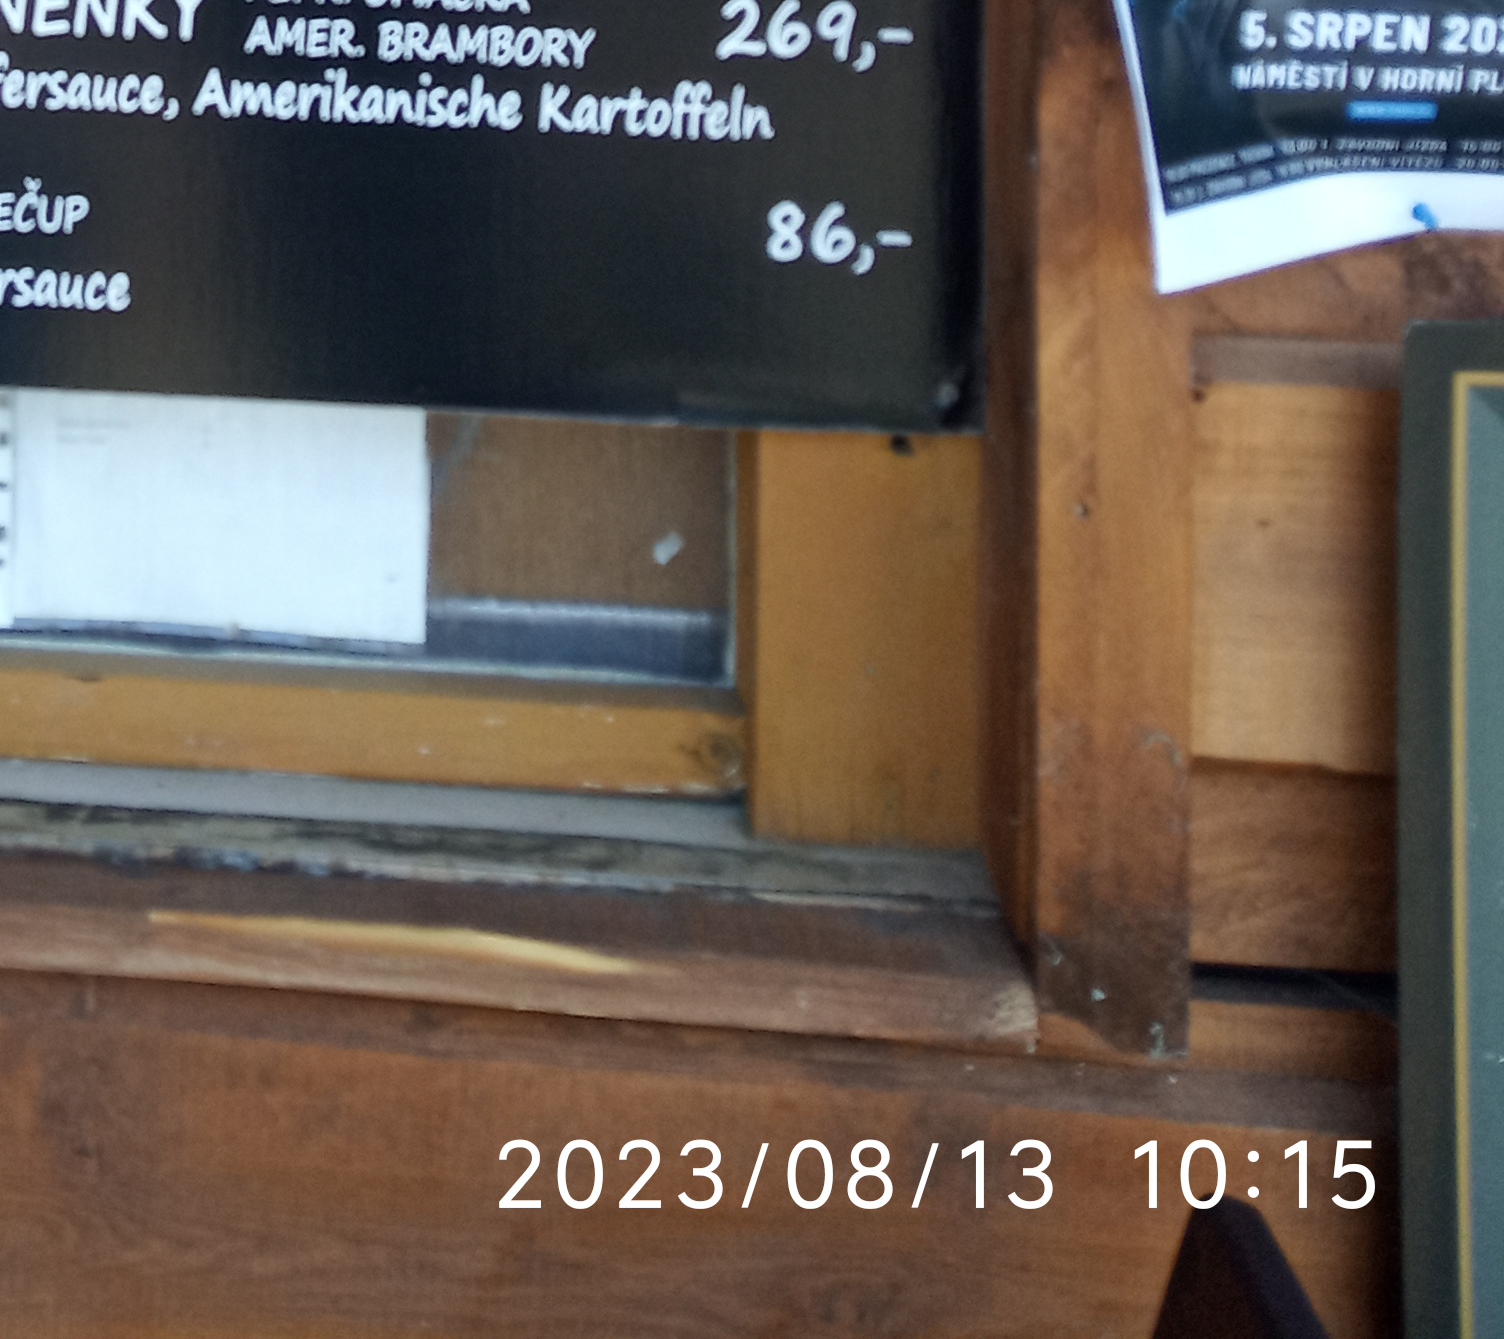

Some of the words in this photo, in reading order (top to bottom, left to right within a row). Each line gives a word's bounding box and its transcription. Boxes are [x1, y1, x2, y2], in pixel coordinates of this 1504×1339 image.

[243, 15, 366, 58] AMER.
[377, 19, 597, 69] BRAMBORY
[1240, 11, 1277, 50] 5.
[1285, 11, 1432, 53] SRPEN
[1439, 14, 1504, 55] 20
[192, 67, 523, 131] Amerikanische
[537, 80, 775, 141] Kartoffeln
[1353, 66, 1374, 91] V
[1468, 69, 1504, 94] PL
[766, 200, 913, 275] 86,-
